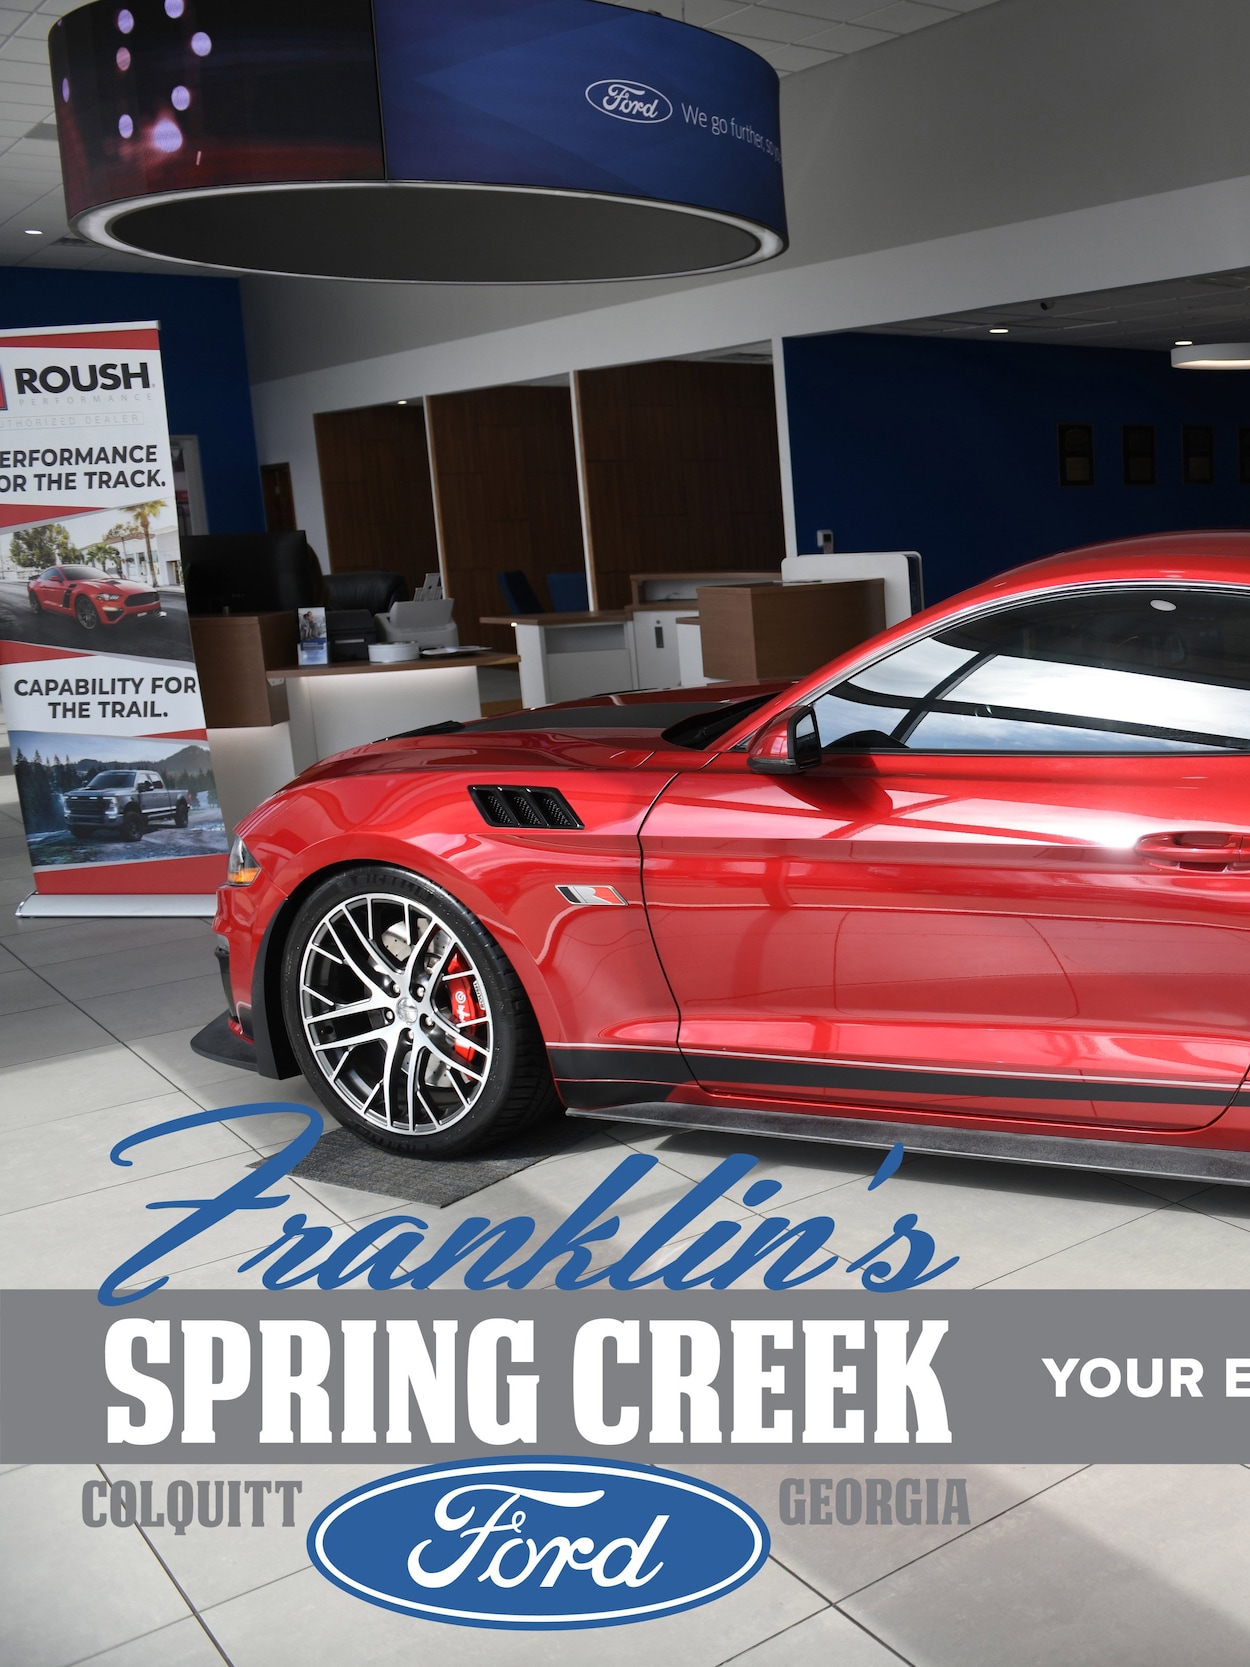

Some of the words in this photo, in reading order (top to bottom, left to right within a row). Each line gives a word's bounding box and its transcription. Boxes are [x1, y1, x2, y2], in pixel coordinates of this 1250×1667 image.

[602, 84, 659, 118] Ford
[681, 102, 708, 128] We
[711, 115, 728, 135] go
[730, 117, 765, 152] further,
[14, 362, 151, 395] ROUSH
[19, 392, 153, 406] PERFORMANCE
[0, 416, 76, 429] UTHORIZED
[85, 414, 138, 425] DEALER
[0, 445, 157, 468] ERFORMANCE
[0, 474, 27, 493] OR
[33, 472, 77, 491] THE
[84, 469, 166, 490] TRACK.
[13, 677, 145, 696] CAPABILITY
[151, 676, 196, 694] FOR
[48, 701, 90, 719] THE
[98, 700, 168, 718] TRAIL.
